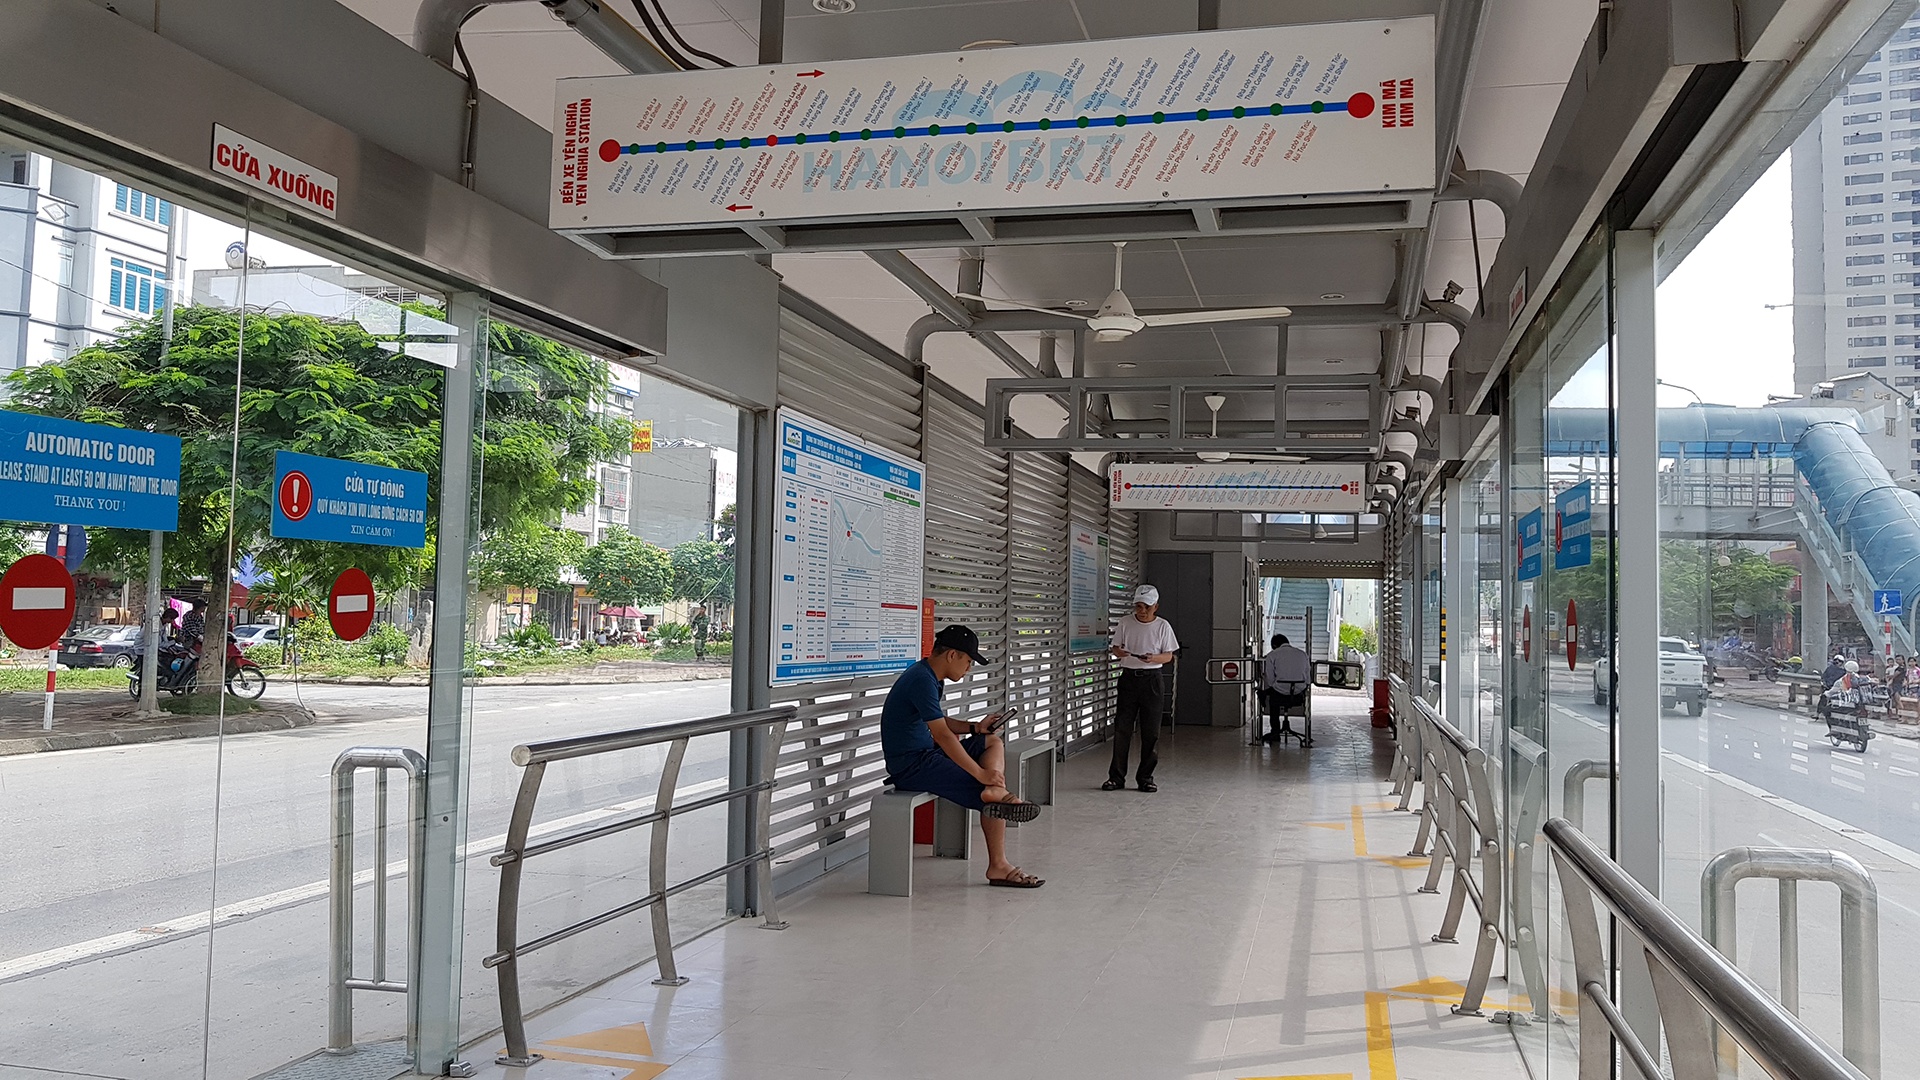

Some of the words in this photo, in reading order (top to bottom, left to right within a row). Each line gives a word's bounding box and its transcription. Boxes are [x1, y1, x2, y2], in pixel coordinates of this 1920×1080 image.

[1166, 92, 1180, 107] Hoang
[1175, 81, 1184, 92] Dao
[1188, 52, 1201, 69] Shelter
[1195, 92, 1205, 102] Nhà
[1219, 50, 1230, 62] Phan
[1215, 72, 1226, 84] Phan
[1223, 54, 1235, 72] Shelter
[1237, 89, 1246, 99] Nhà
[1258, 51, 1270, 64] Công
[1245, 86, 1257, 100] Thanh
[1254, 73, 1266, 86] Cong
[1261, 56, 1274, 73] Shelter
[1284, 85, 1297, 99] Giang
[1297, 61, 1310, 78] Shelter
[1315, 83, 1325, 93] Nhà
[1332, 53, 1342, 63] Trúc
[1328, 75, 1339, 85] Truc
[1335, 58, 1348, 75] Shelter
[817, 94, 829, 110] Shelter
[1008, 104, 1016, 114] Nhà
[1018, 82, 1031, 94] Trung
[1015, 102, 1027, 115] Trung
[1023, 93, 1031, 102] Van
[1028, 77, 1041, 93] Shelter
[1158, 95, 1167, 105] Nhà
[1276, 87, 1285, 98] Nhà
[1379, 79, 1396, 99] MÃ
[1400, 78, 1413, 98] MA
[733, 102, 744, 117] Shelter
[782, 115, 790, 124] Khe
[787, 101, 799, 115] Bridge
[796, 85, 807, 100] Shelter
[1382, 103, 1396, 128] KIM
[1400, 103, 1413, 127] KIM
[564, 102, 578, 136] NGHĨA
[579, 98, 591, 143] STATION
[718, 122, 726, 131] Nhà
[773, 116, 782, 126] Nhà
[799, 118, 808, 127] Nhà
[563, 139, 575, 160] YÊN
[1201, 163, 1211, 173] Nhà
[1212, 138, 1225, 152] Thành
[1222, 125, 1234, 138] Công
[1209, 160, 1222, 175] Thanh
[1218, 147, 1230, 160] Cong
[1226, 130, 1239, 147] Shelter
[1284, 150, 1294, 160] Nhà
[1301, 120, 1311, 130] Trúc
[1297, 142, 1308, 153] Truc
[1304, 125, 1317, 142] Shelter
[217, 144, 260, 181] CỬA
[267, 164, 334, 211] XUỐNG
[564, 164, 574, 177] XE
[577, 147, 588, 180] NGHIA
[802, 141, 992, 193] HANOI
[1008, 134, 1126, 182] BRT
[559, 182, 573, 203] BẾN
[576, 184, 587, 206] YEN
[26, 432, 113, 461] AUTOMATIC
[118, 444, 155, 466] DOOR
[25, 463, 49, 484] STAND
[51, 466, 60, 484] AT
[61, 468, 83, 488] LEAST
[84, 470, 93, 488] 50
[95, 472, 106, 489] CM
[107, 473, 127, 491] AWAY
[129, 476, 147, 493] FROM
[148, 478, 160, 495] THE
[161, 480, 177, 496] DOOR
[345, 471, 364, 493] CỬA
[367, 478, 380, 498] TỰ
[380, 479, 404, 499] ĐỘNG
[54, 495, 94, 509] THANK
[98, 499, 120, 510] YOU
[317, 496, 328, 514] QUÝ
[329, 498, 347, 515] KHÁCH
[348, 502, 357, 516] XIN
[358, 503, 367, 518] VUI
[368, 501, 380, 519] LÒNG
[396, 505, 408, 522] CÁCH
[409, 510, 415, 522] 50
[416, 510, 424, 523] CM
[351, 525, 364, 534] XIN
[366, 524, 381, 536] CẢM
[382, 527, 392, 537] ƠN
